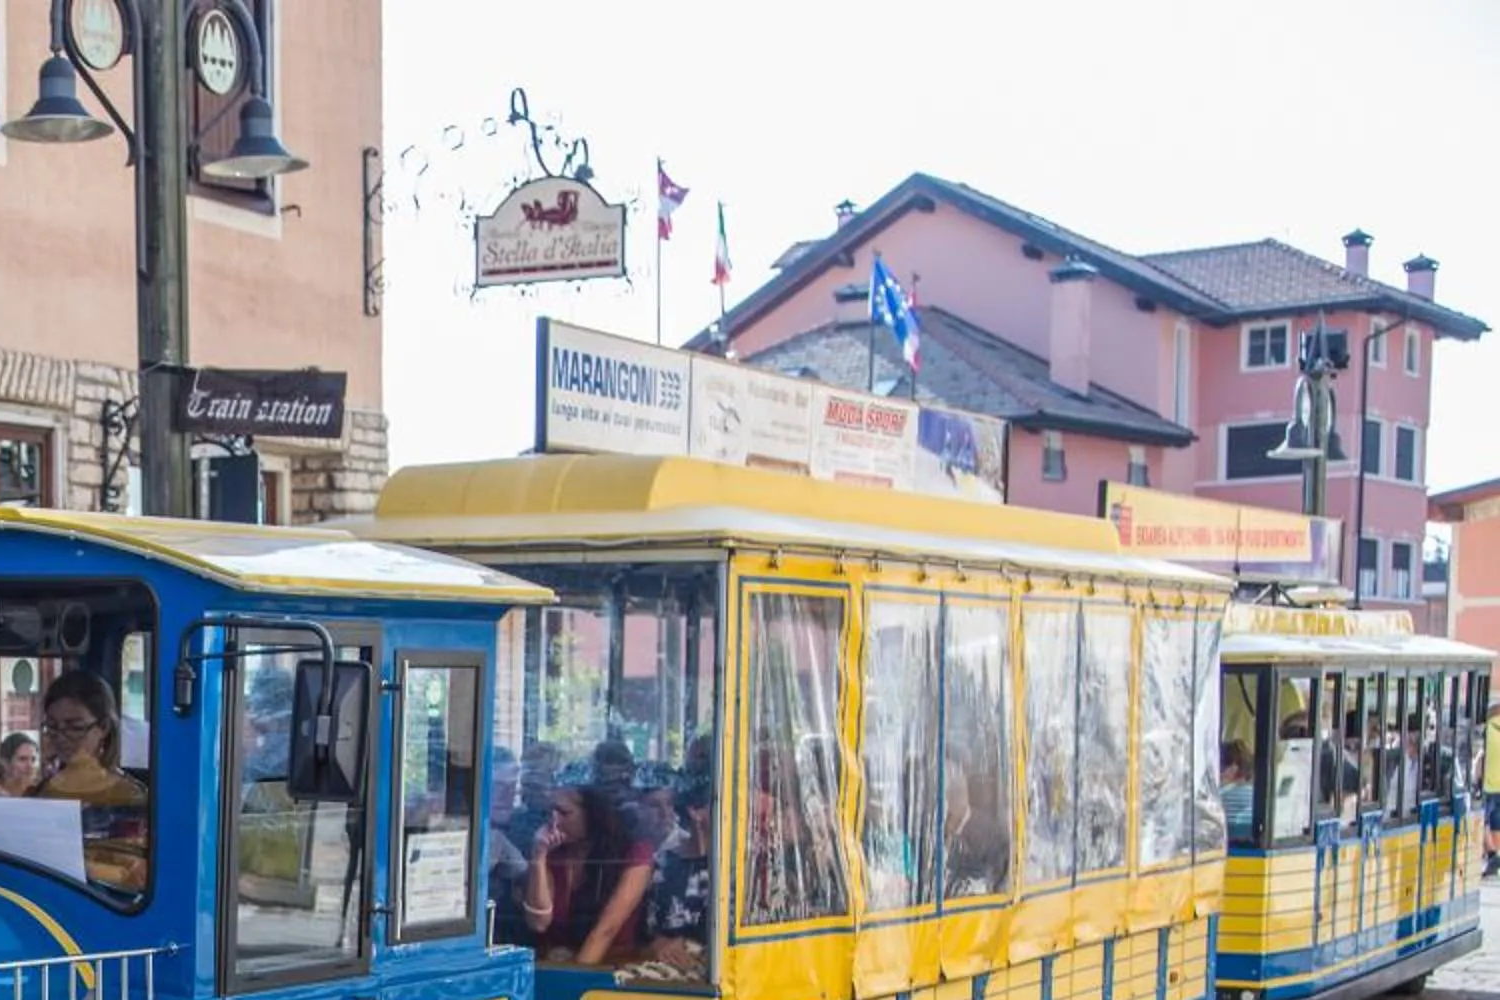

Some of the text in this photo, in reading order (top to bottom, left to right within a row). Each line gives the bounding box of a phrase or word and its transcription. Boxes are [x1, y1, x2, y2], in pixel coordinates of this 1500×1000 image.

[552, 347, 658, 407] MARANGONI
[187, 388, 332, 425] Train station
